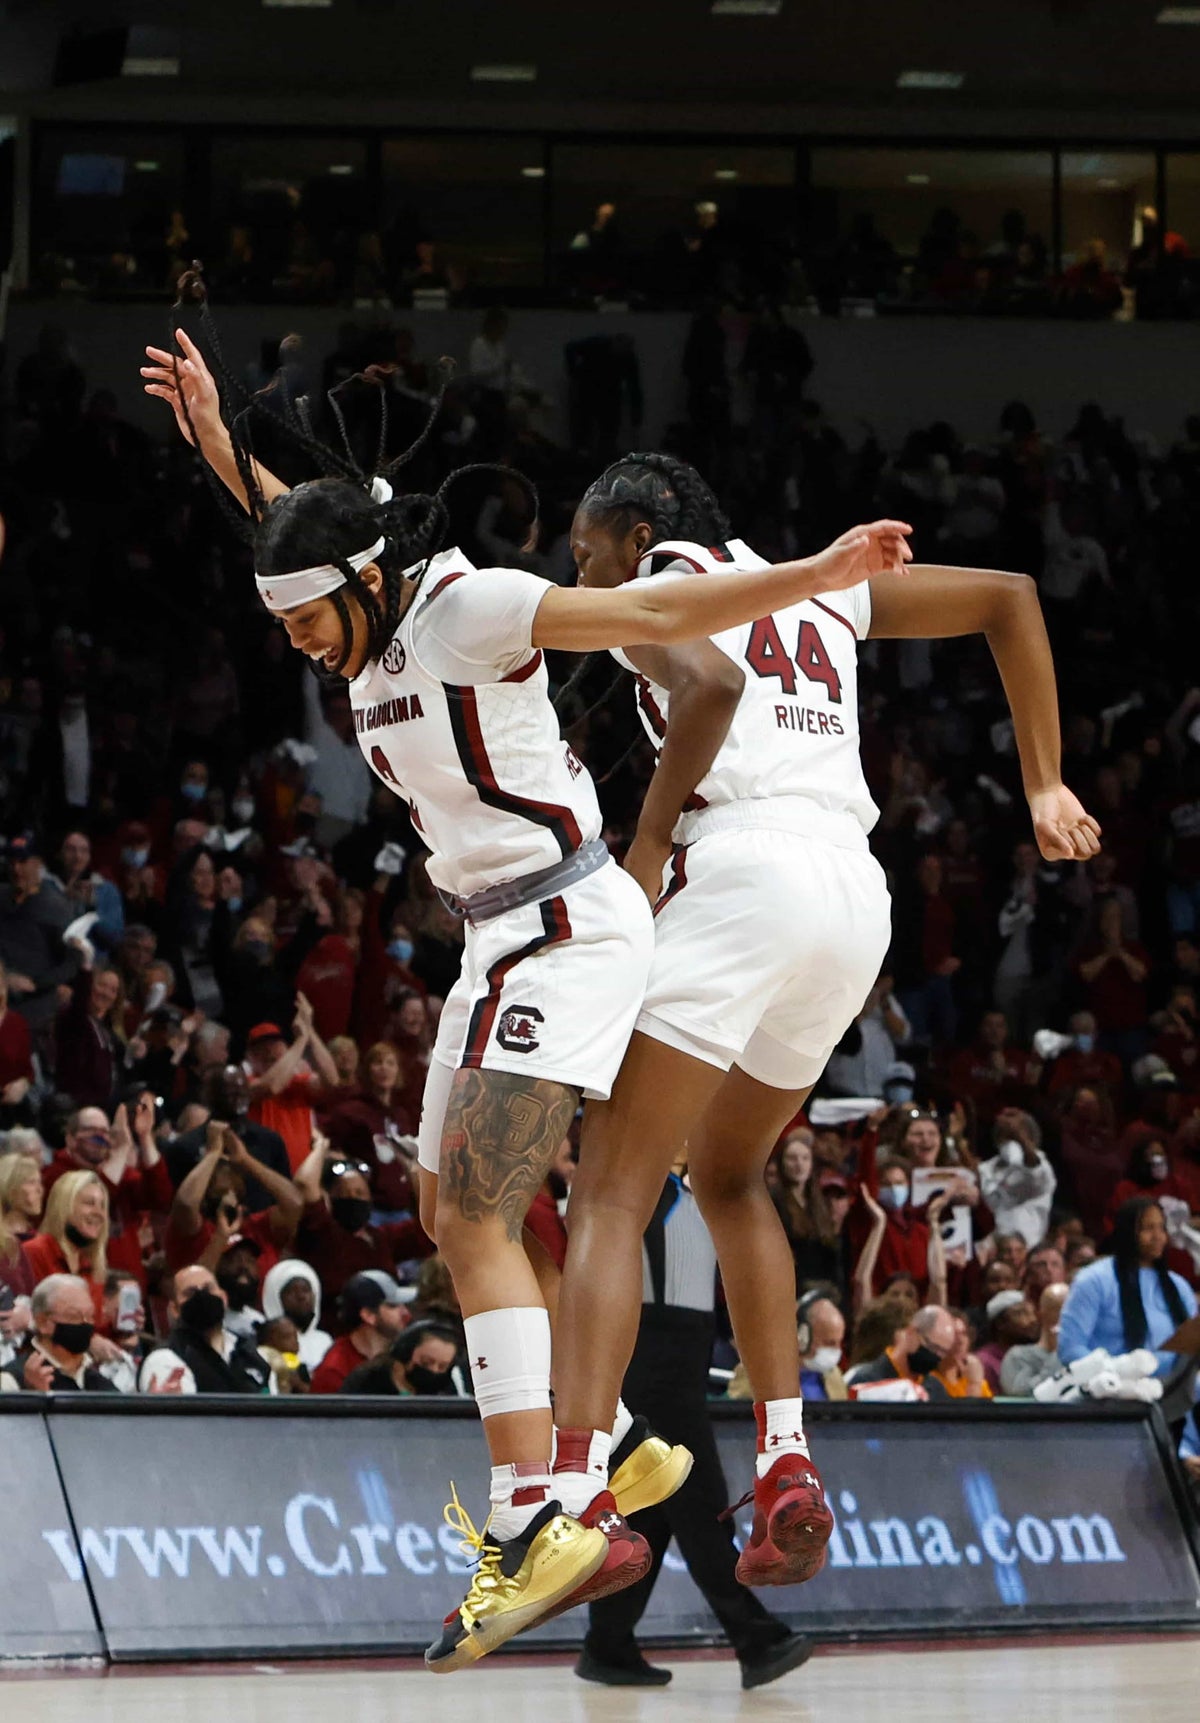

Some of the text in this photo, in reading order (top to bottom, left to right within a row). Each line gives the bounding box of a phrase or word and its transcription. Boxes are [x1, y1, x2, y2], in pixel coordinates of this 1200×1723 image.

[383, 639, 405, 673] SEC
[744, 614, 842, 704] 44
[367, 694, 424, 731] CAROLINA
[774, 705, 845, 735] RIVERS
